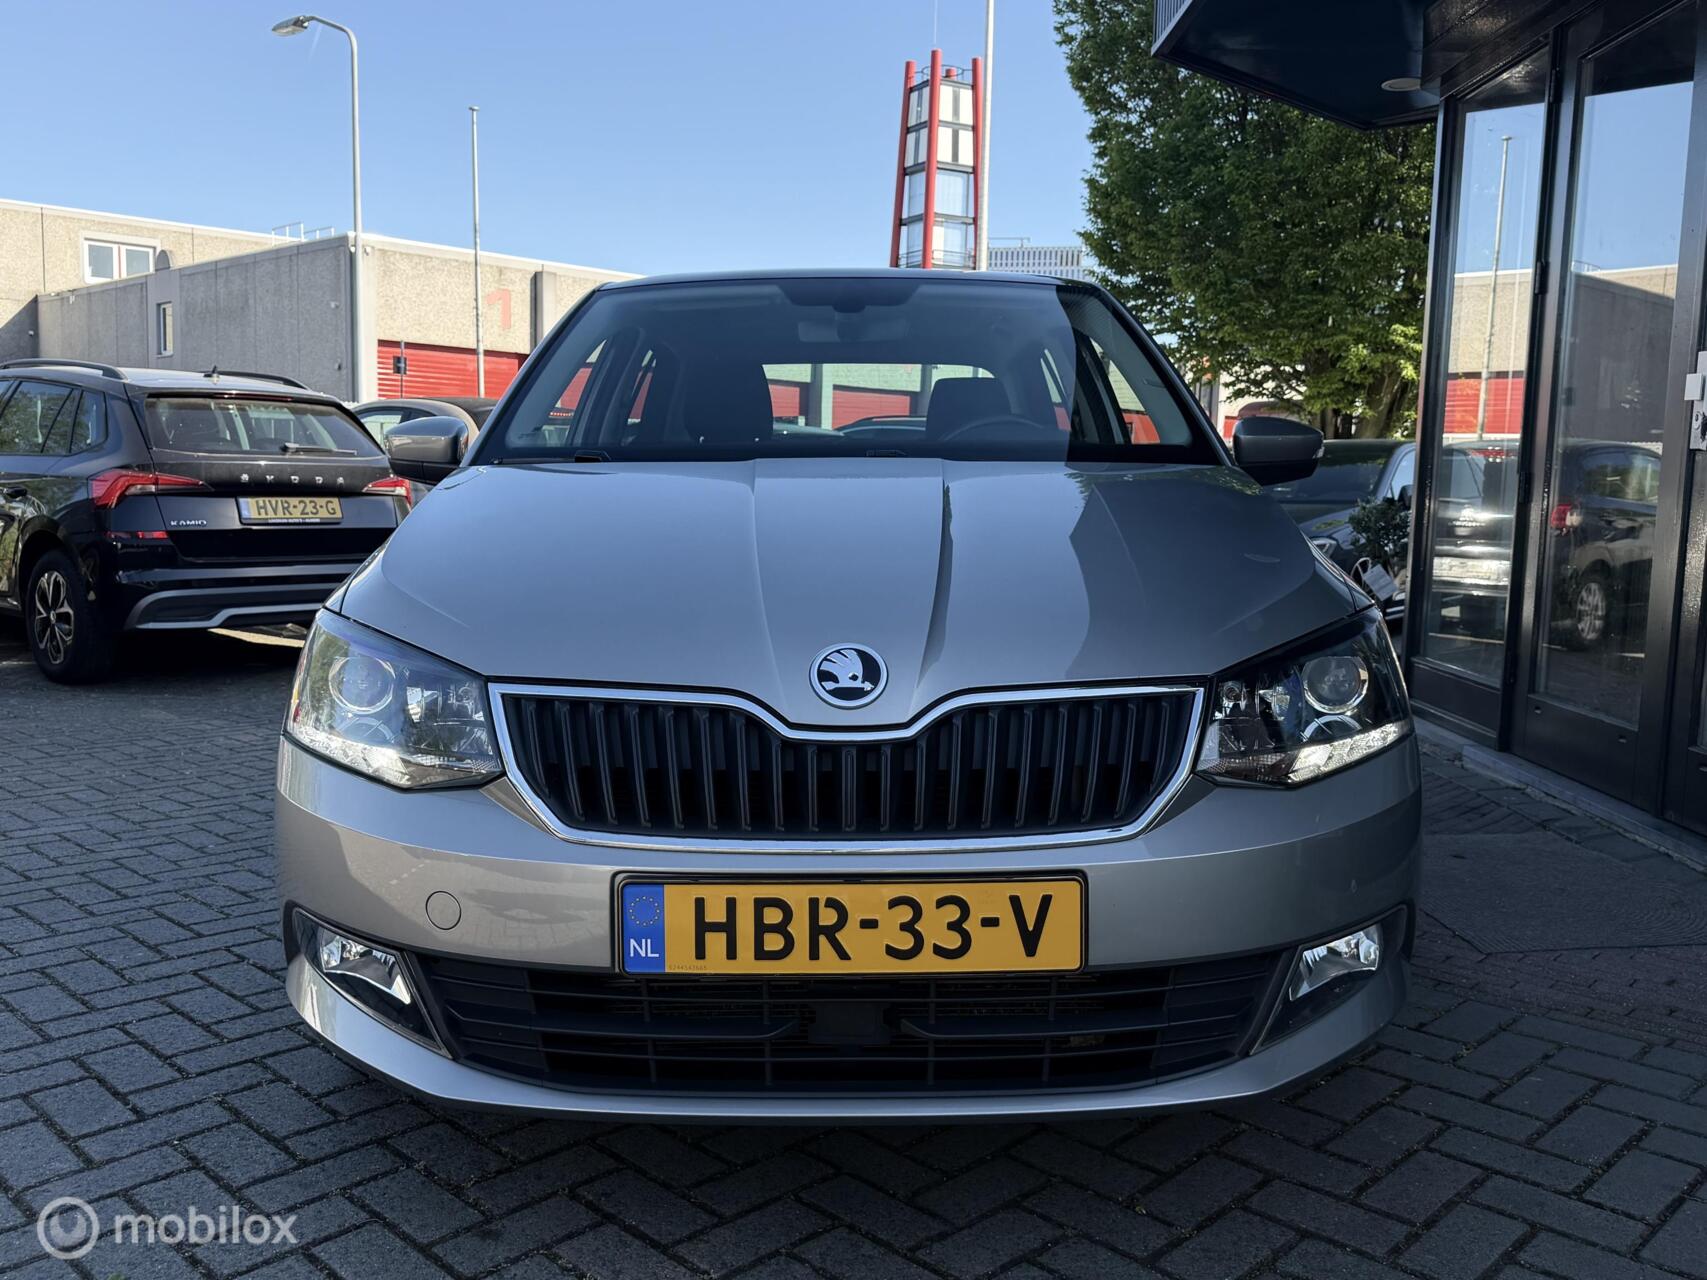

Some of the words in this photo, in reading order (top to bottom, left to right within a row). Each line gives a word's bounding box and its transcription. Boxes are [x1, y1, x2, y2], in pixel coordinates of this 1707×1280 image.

[486, 288, 511, 330] 1
[255, 499, 337, 516] HVR-23-G
[694, 894, 1053, 961] HBR-33-V
[629, 938, 660, 958] NL
